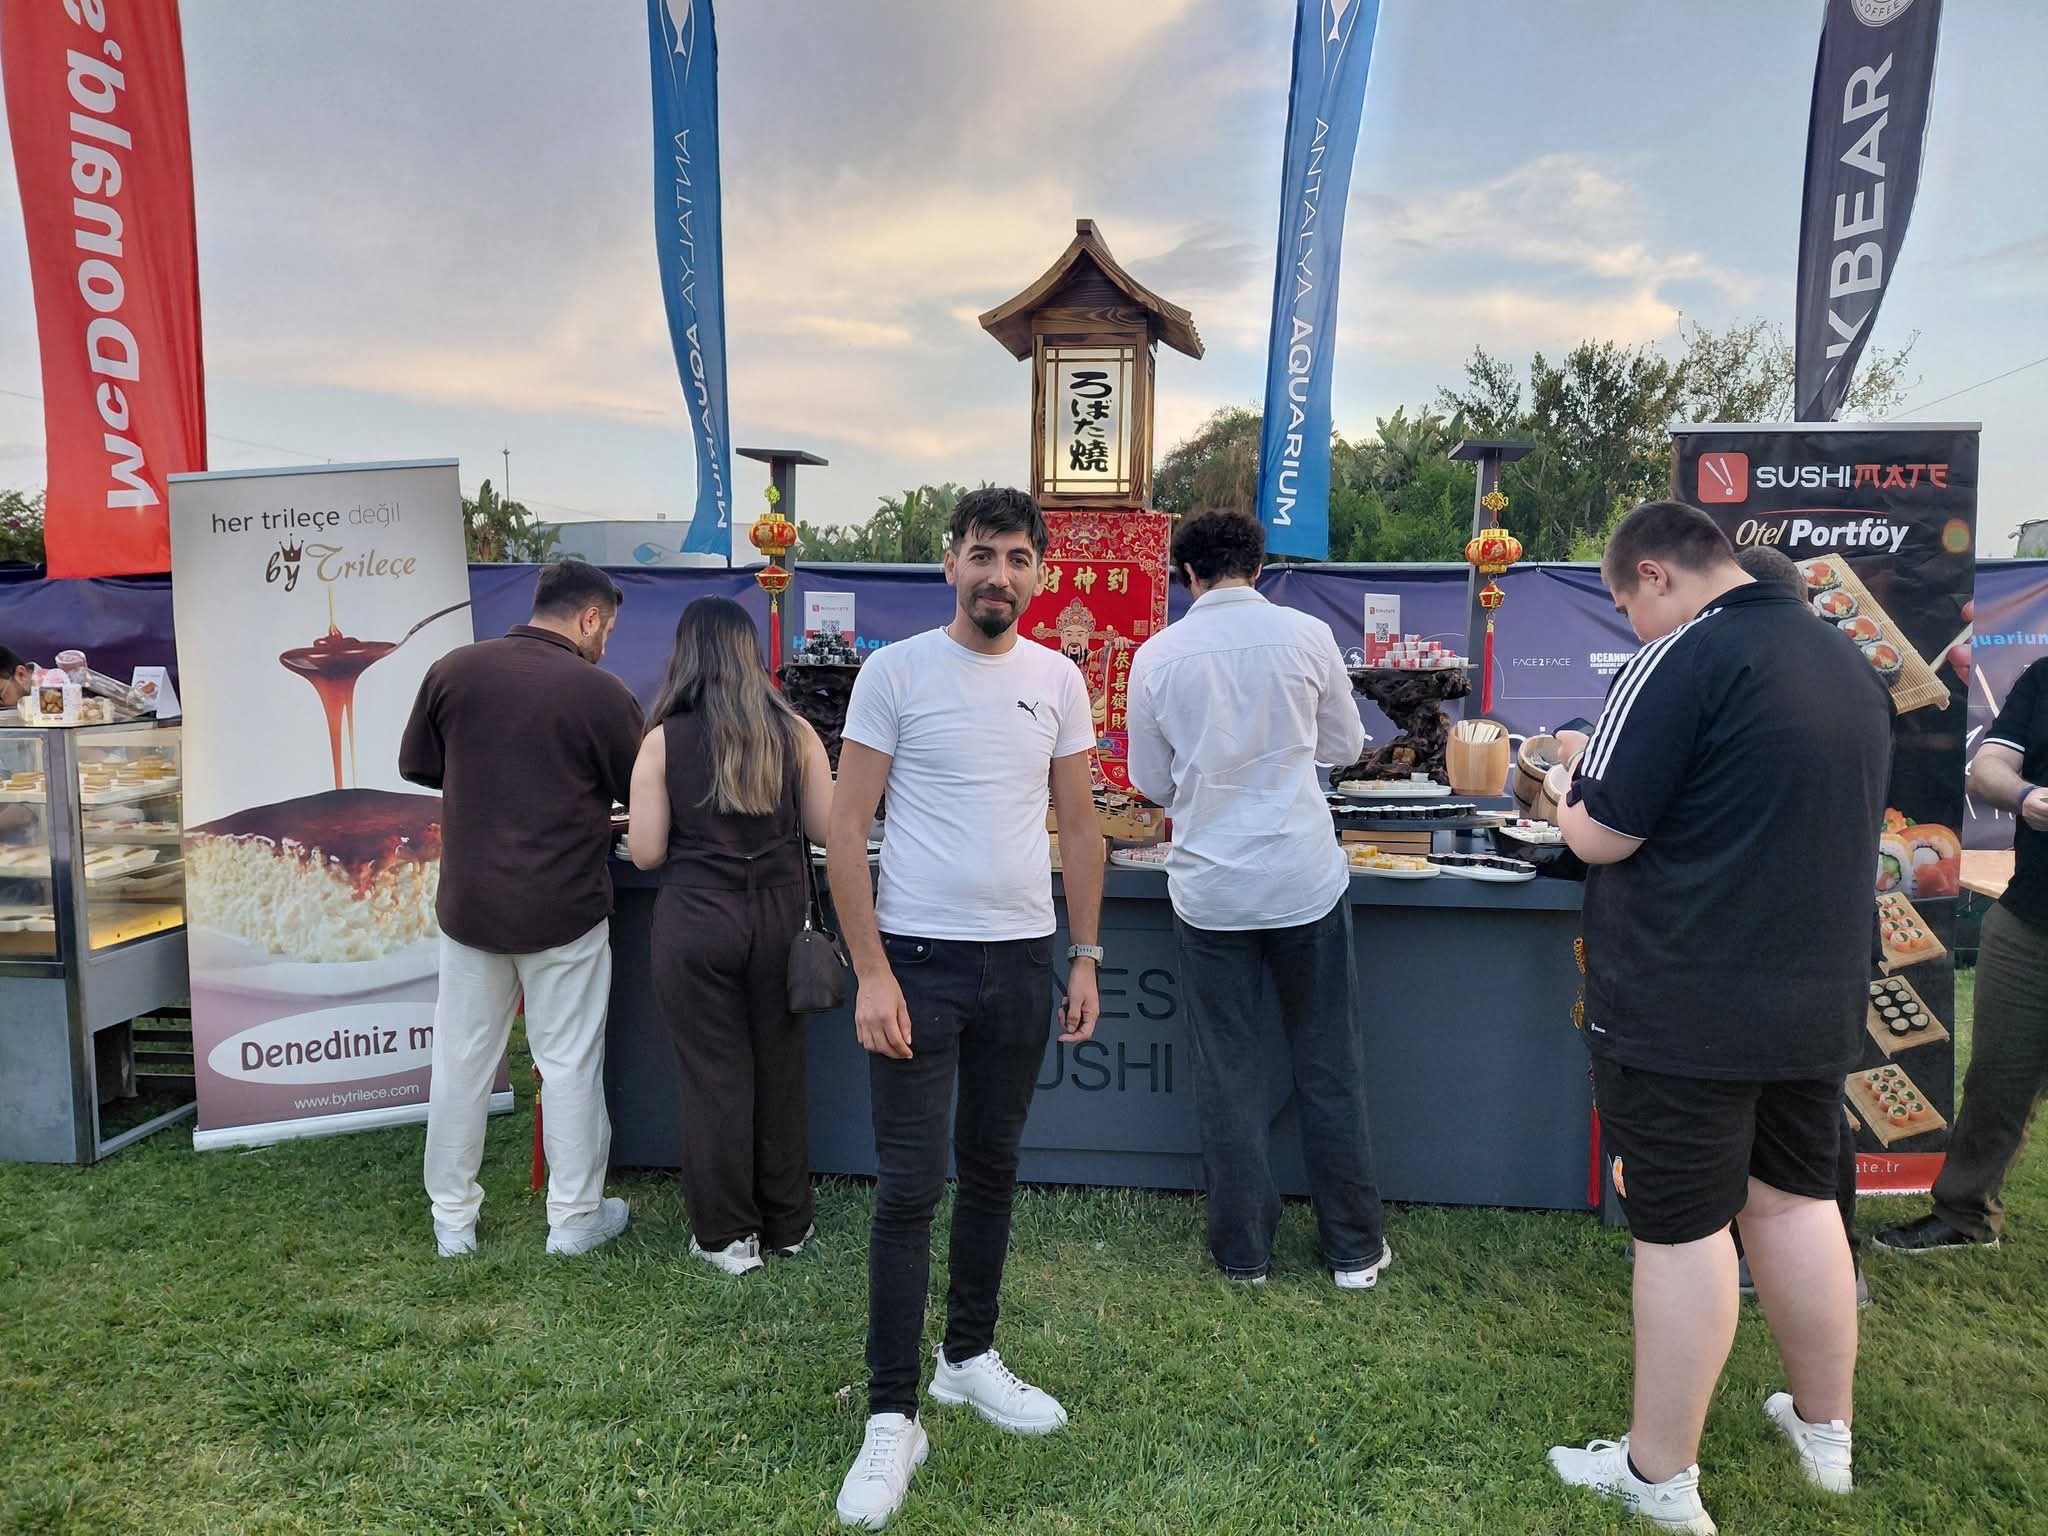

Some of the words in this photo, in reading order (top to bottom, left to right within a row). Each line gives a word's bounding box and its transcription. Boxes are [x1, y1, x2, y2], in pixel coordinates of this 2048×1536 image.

[1294, 116, 1330, 304] ANTALYA
[1271, 315, 1314, 527] AQUARIUM
[211, 512, 254, 534] her
[262, 508, 341, 533] trileçe
[348, 502, 401, 527] değil
[1735, 518, 1788, 548] Otel
[1789, 518, 1910, 553] Portföy
[265, 552, 301, 593] by
[304, 542, 418, 583] Trileçe
[240, 1026, 398, 1072] Denediniz
[294, 1083, 420, 1111] www.bytrilece.com
